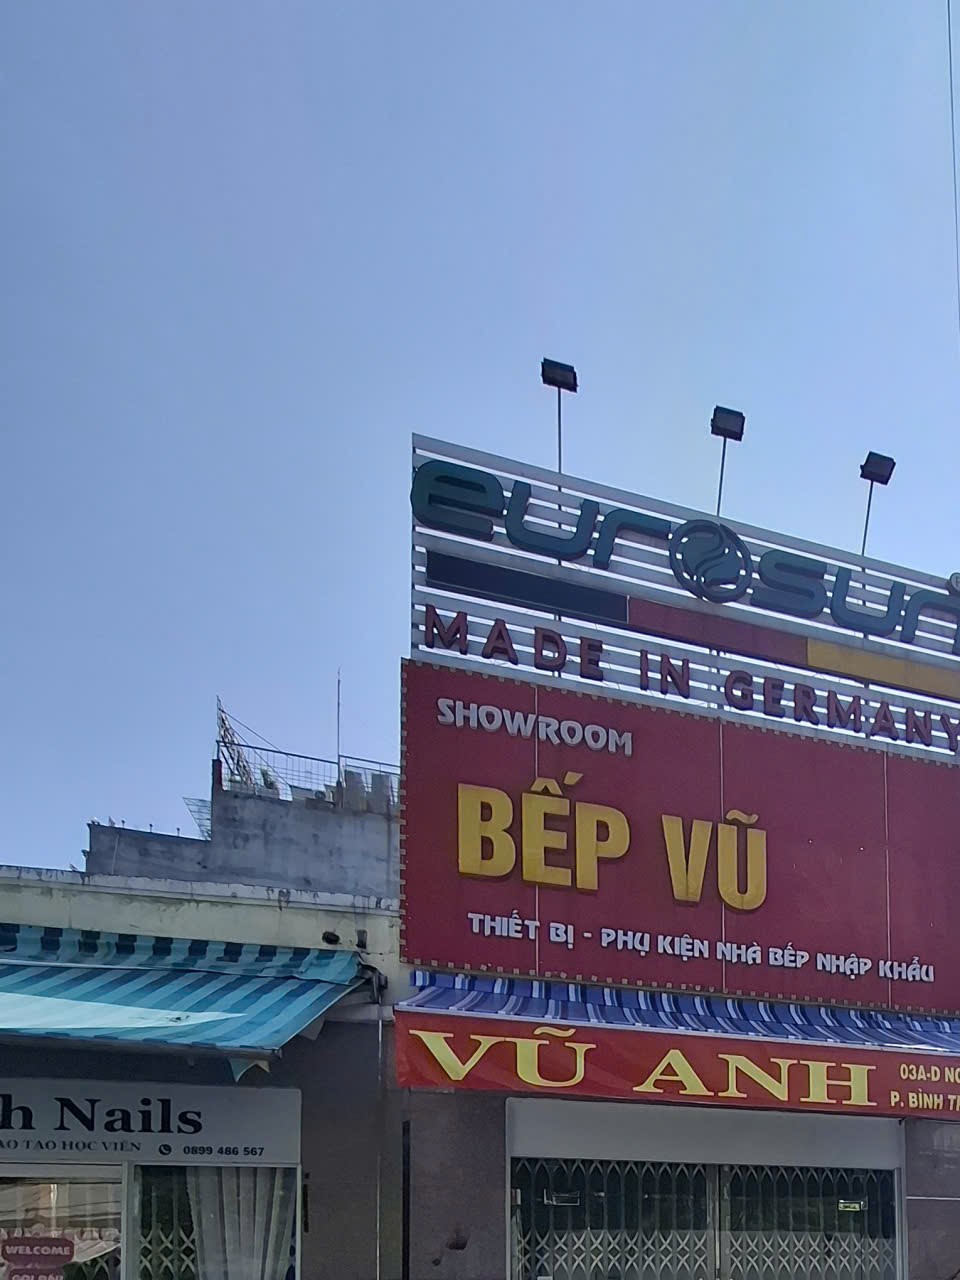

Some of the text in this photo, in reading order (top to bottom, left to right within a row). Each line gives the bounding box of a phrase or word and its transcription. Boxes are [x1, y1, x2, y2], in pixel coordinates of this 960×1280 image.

[424, 603, 604, 682] MADE
[639, 648, 690, 699] IN
[437, 698, 632, 757] SHOWROOM
[458, 771, 767, 910] BẾP VŨ
[468, 909, 540, 940] THIẾT
[550, 922, 574, 949] BỊ
[601, 928, 650, 957] PHỤ
[657, 933, 709, 961] KIỆN
[716, 941, 762, 965] NHÀ
[768, 941, 810, 968] BẾP
[816, 952, 872, 979] NHẬP
[879, 956, 935, 982] KHẨU
[409, 1026, 878, 1106] VŨ ANH
[900, 1063, 941, 1082] 03A-D
[53, 1097, 203, 1134] Nails
[890, 1091, 904, 1108] P.
[908, 1088, 943, 1110] BÌNH
[183, 1146, 264, 1157] 0899 486 567
[6, 1245, 70, 1256] WELCOME
